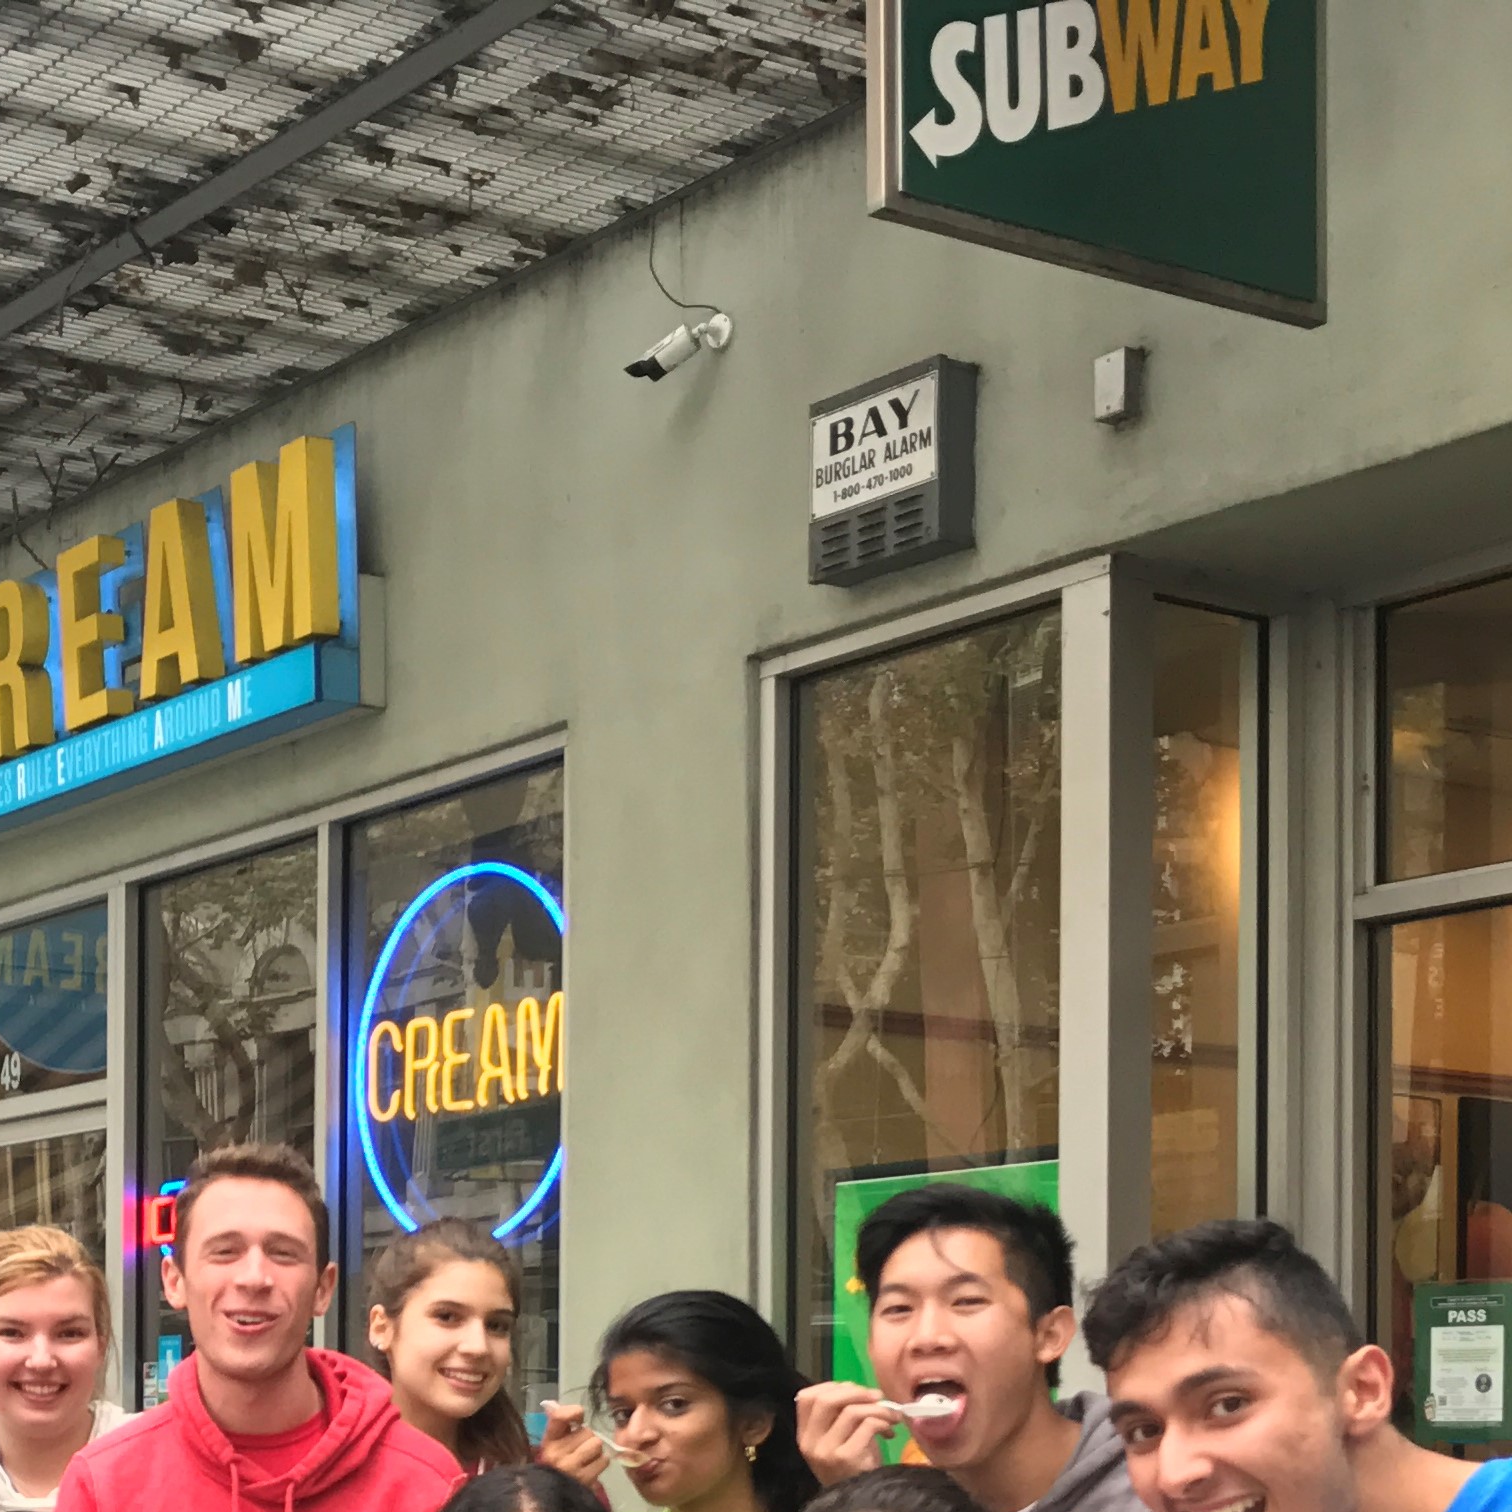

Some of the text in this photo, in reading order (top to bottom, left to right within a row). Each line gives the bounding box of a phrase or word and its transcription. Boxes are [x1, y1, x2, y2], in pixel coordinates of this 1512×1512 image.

[909, 0, 1269, 168] SUBWAY
[829, 388, 920, 457] BAY
[815, 426, 932, 489] BURGLAR ALARM
[833, 463, 913, 502] 1-800-470-1000
[16, 752, 53, 801] RULE
[57, 716, 148, 788] EVERYTHING
[153, 688, 222, 750] AROUND
[226, 674, 253, 723] ME
[0, 1051, 21, 1091] 49
[368, 991, 564, 1122] CREAM
[1448, 1309, 1487, 1323] PASS
